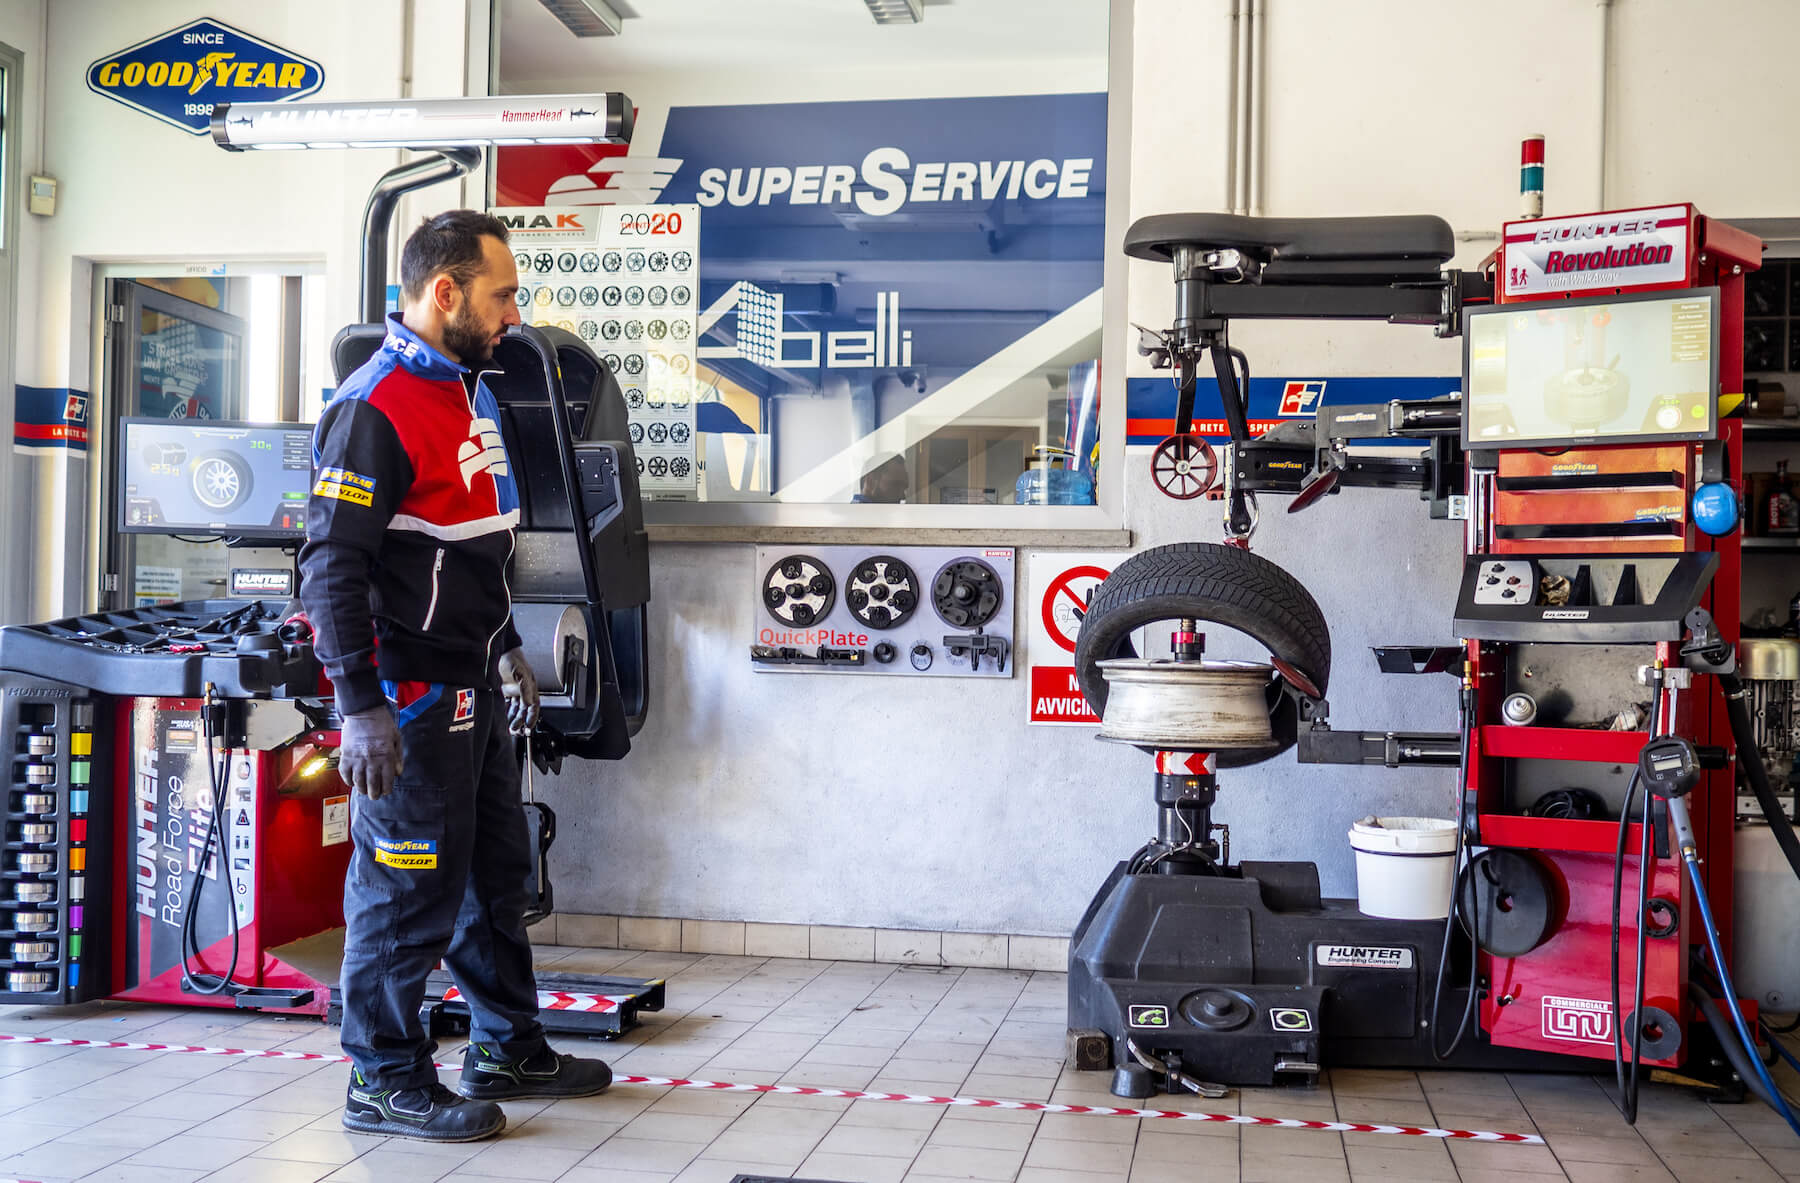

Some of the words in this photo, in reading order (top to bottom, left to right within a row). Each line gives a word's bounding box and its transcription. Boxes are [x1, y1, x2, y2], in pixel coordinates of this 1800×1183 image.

[183, 33, 225, 45] SINCE
[99, 61, 306, 89] GOODYEAR
[184, 104, 214, 116] 1898
[501, 109, 563, 123] HammerHead
[497, 213, 585, 229] MAK
[619, 212, 682, 236] 2020
[1533, 216, 1661, 244] HUNTER
[1544, 242, 1673, 274] Revolution
[1200, 423, 1225, 433] RETE
[1770, 496, 1779, 526] MOTUL
[759, 628, 869, 647] QuickPlate
[163, 775, 183, 852] Force
[136, 747, 159, 918] HUNTER
[188, 788, 218, 880] Elite
[162, 855, 182, 928] Road
[1329, 947, 1402, 959] HUNTER
[1550, 998, 1609, 1011] COMMERCIALE
